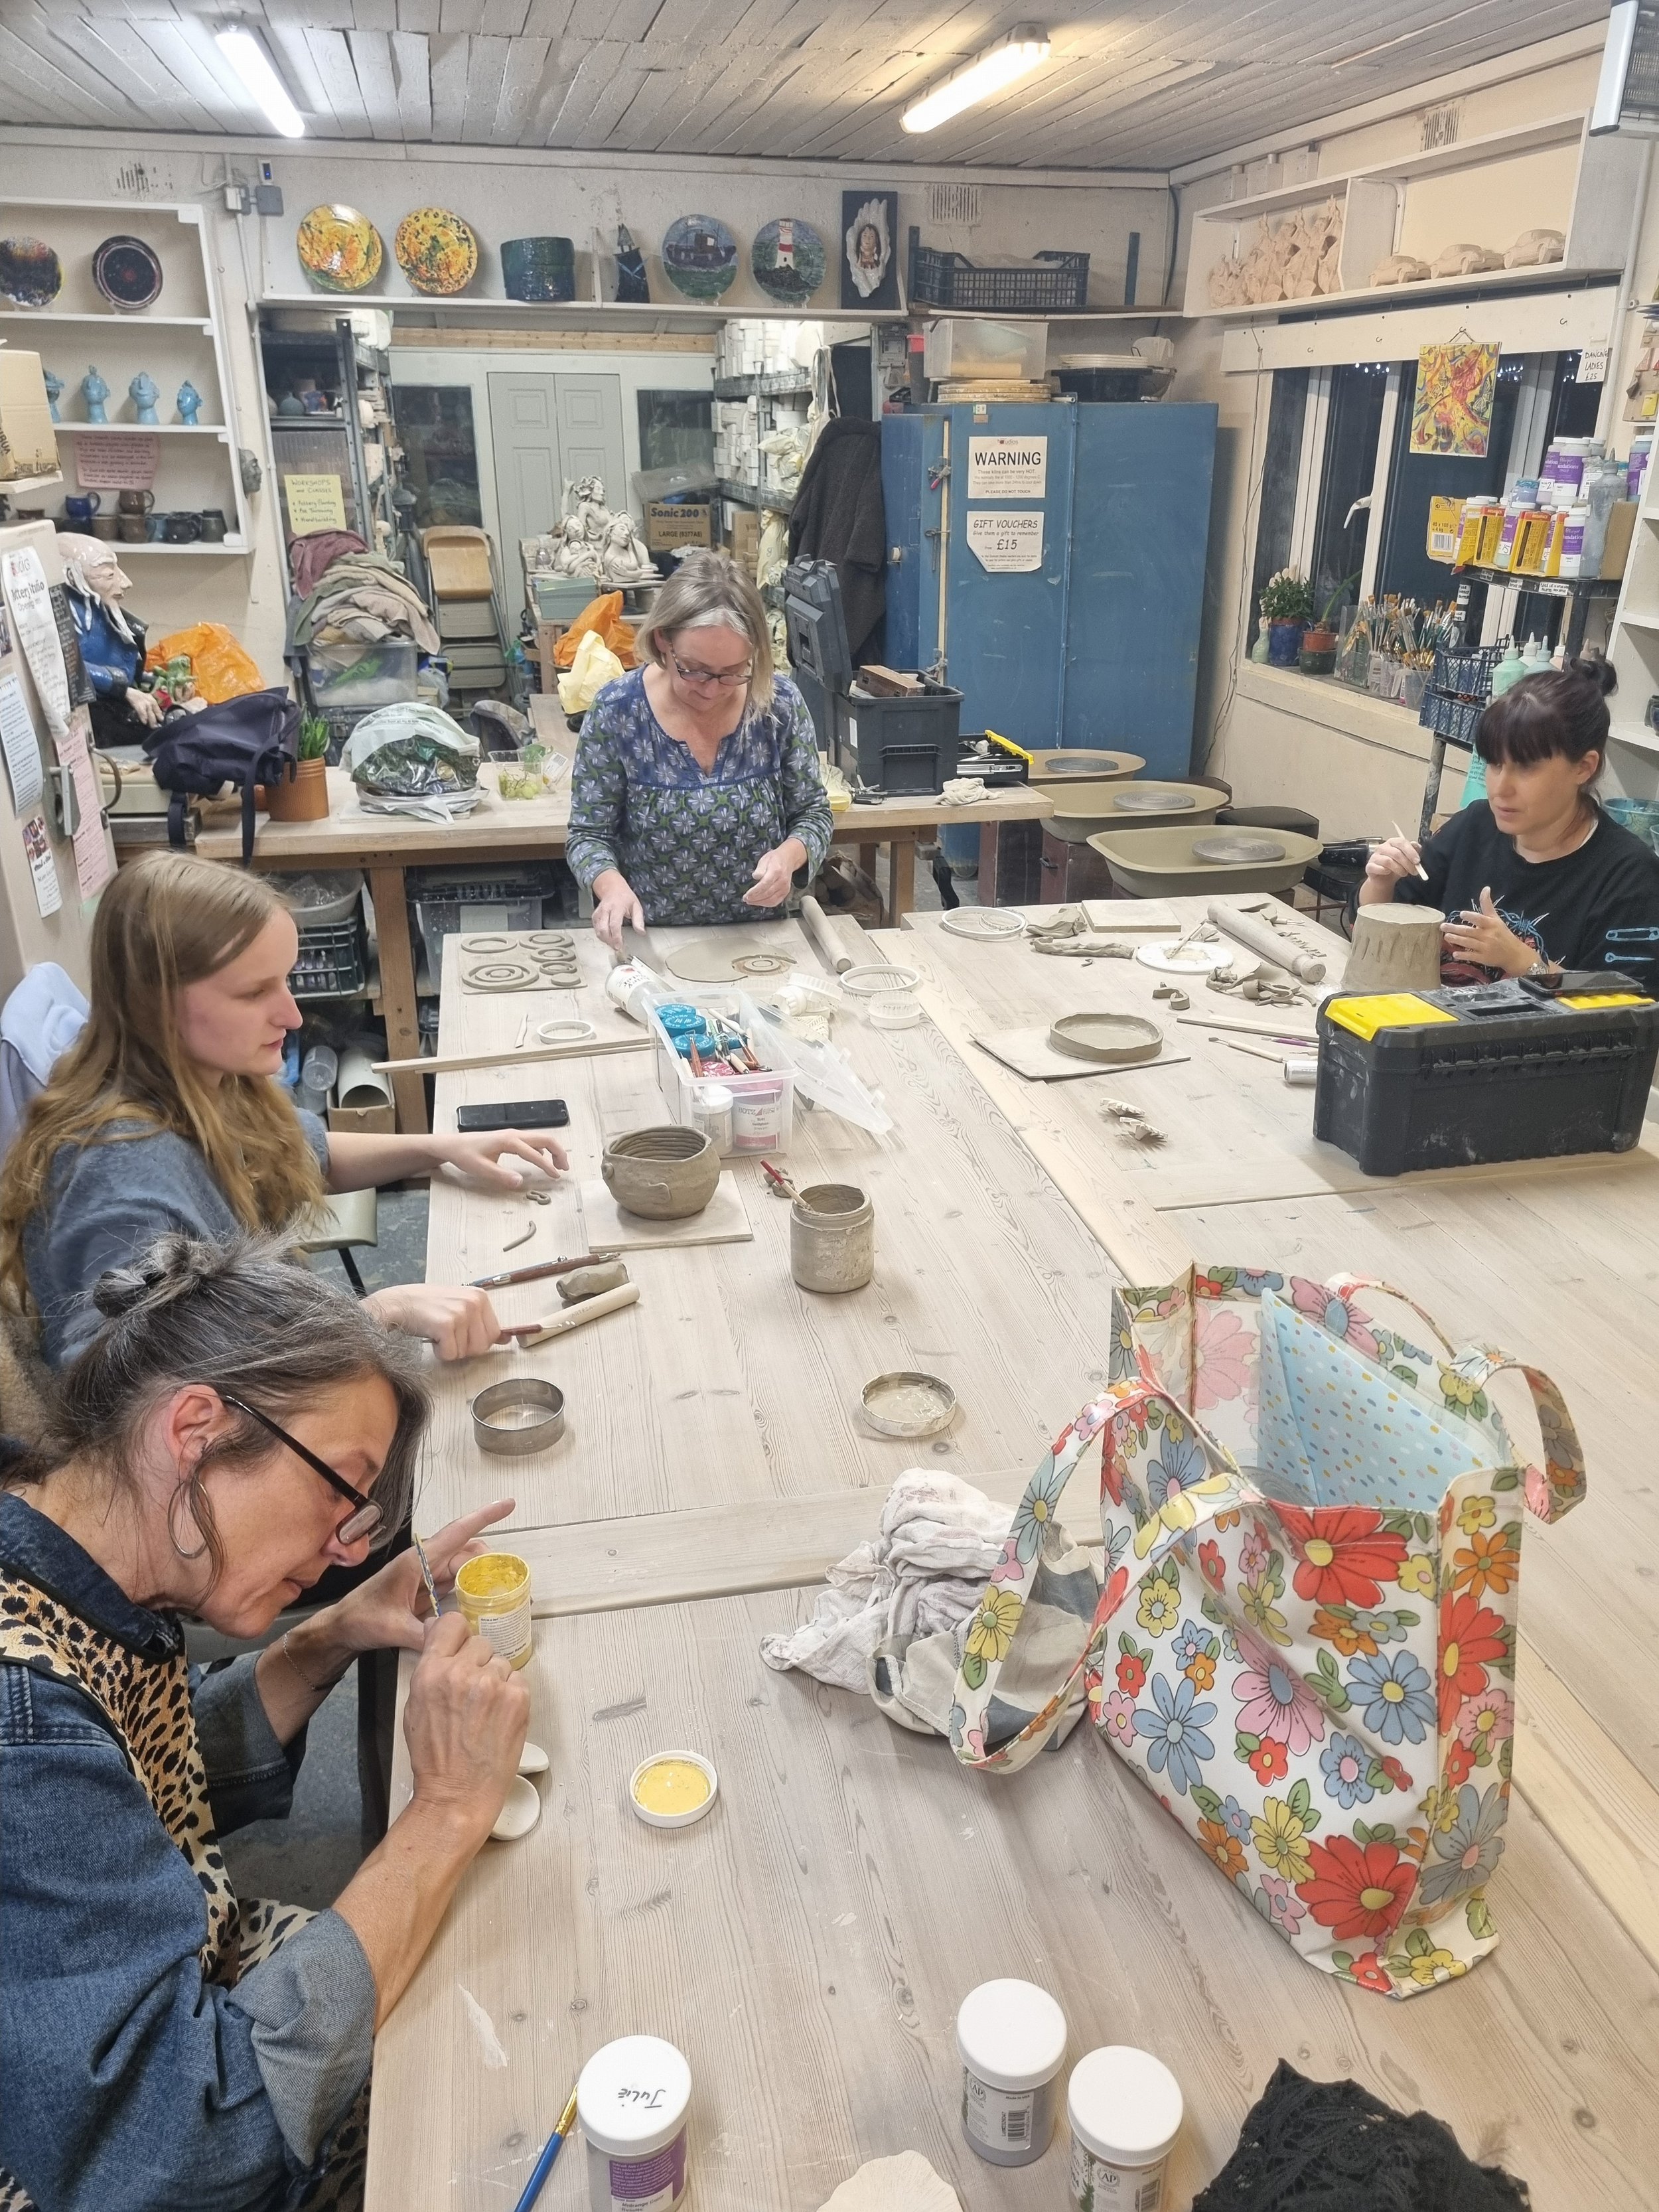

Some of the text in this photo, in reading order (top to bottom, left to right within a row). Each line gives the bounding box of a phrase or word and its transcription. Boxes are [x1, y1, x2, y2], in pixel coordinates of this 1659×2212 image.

[1585, 362, 1604, 371] LADIES
[1585, 372, 1597, 381] £25
[975, 452, 1041, 466] WARNING
[650, 507, 699, 518] Sonic 200
[973, 520, 1039, 528] GIFT VOUCHERS
[997, 539, 1017, 550] £15
[738, 1106, 756, 1116] BOTZ
[972, 2084, 983, 2096] AP
[1102, 2172, 1116, 2183] AP
